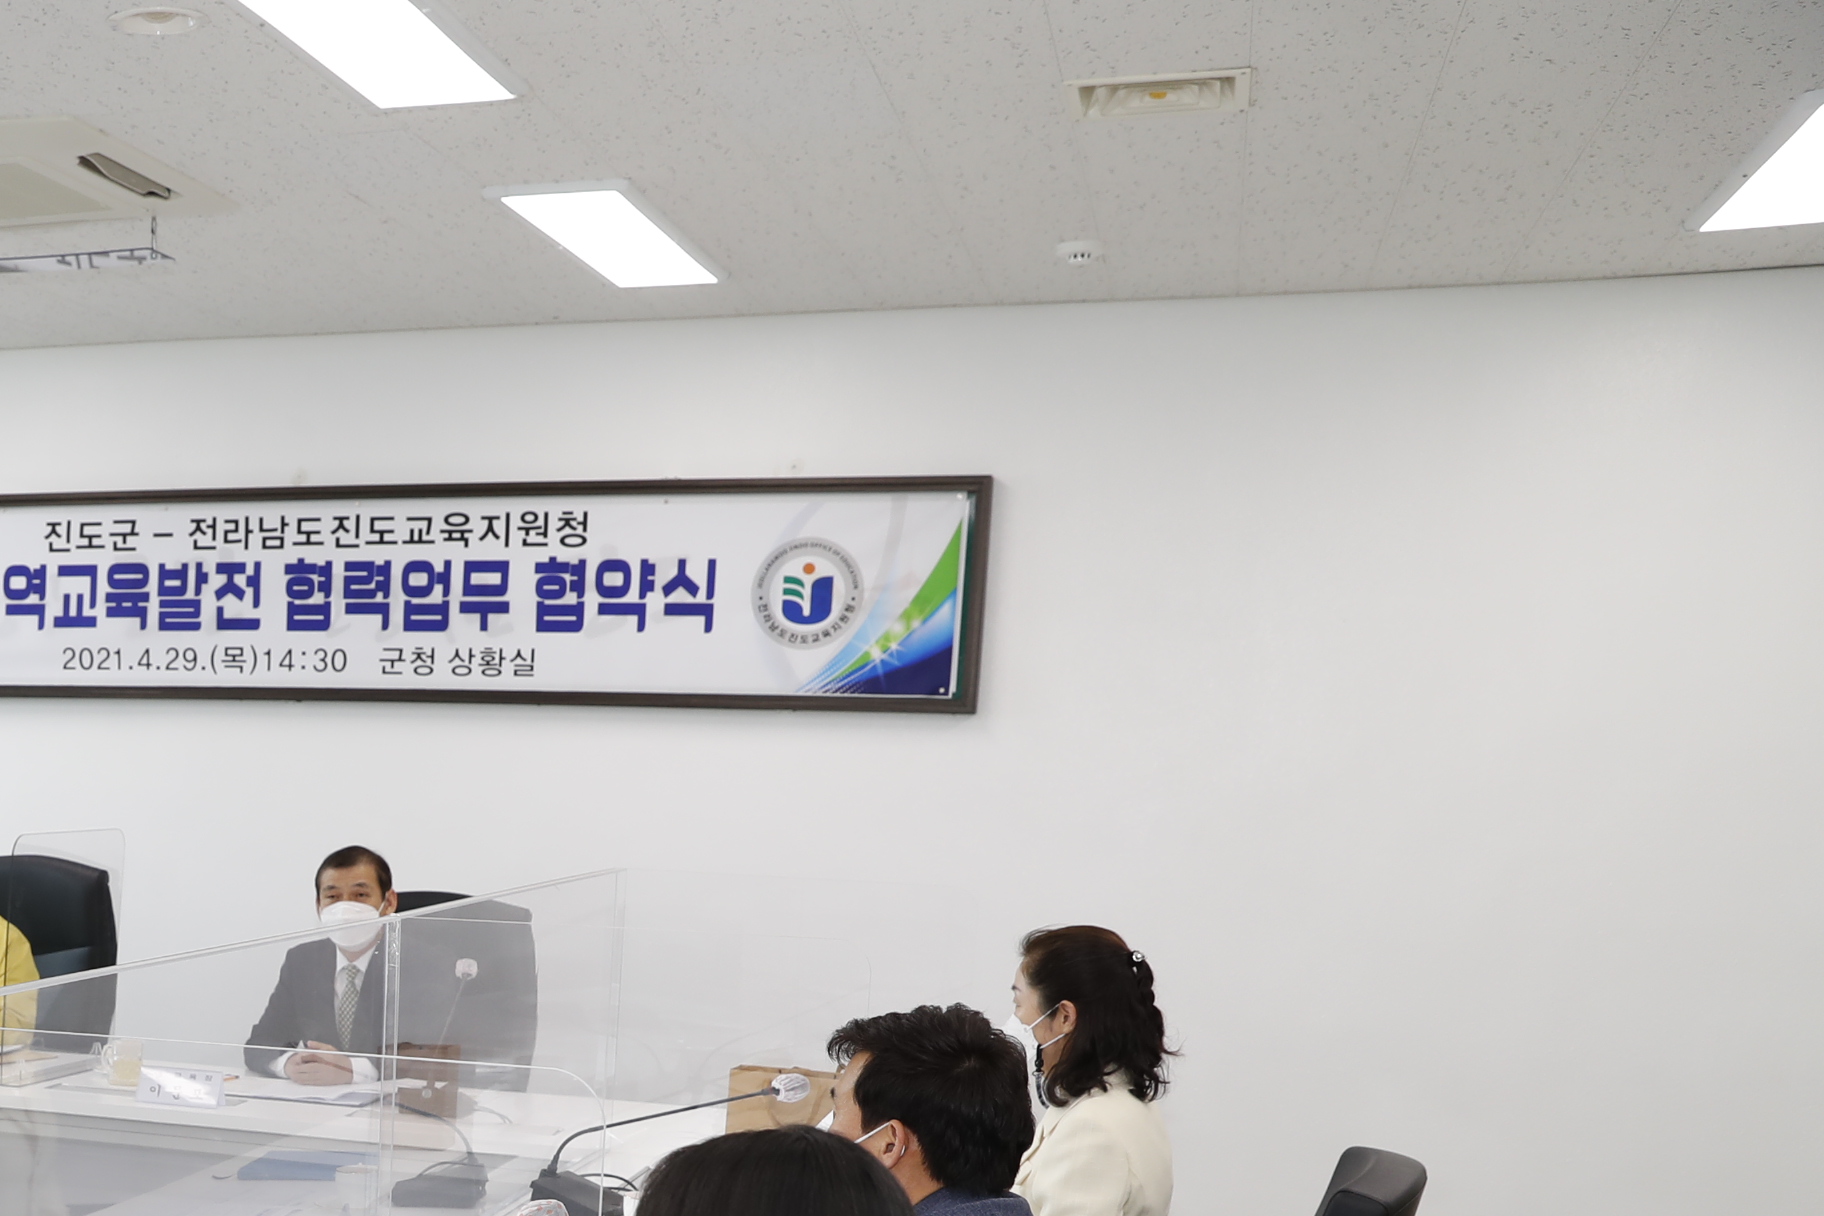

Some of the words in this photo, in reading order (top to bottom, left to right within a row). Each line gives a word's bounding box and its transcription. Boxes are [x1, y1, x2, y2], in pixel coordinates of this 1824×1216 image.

[44, 519, 140, 553] 진도군
[188, 510, 589, 551] 전라남도진도교육지원청
[284, 556, 511, 632] 협력업무
[533, 556, 718, 633] 협약식
[379, 646, 436, 677] 군청
[447, 647, 536, 678] 상황실
